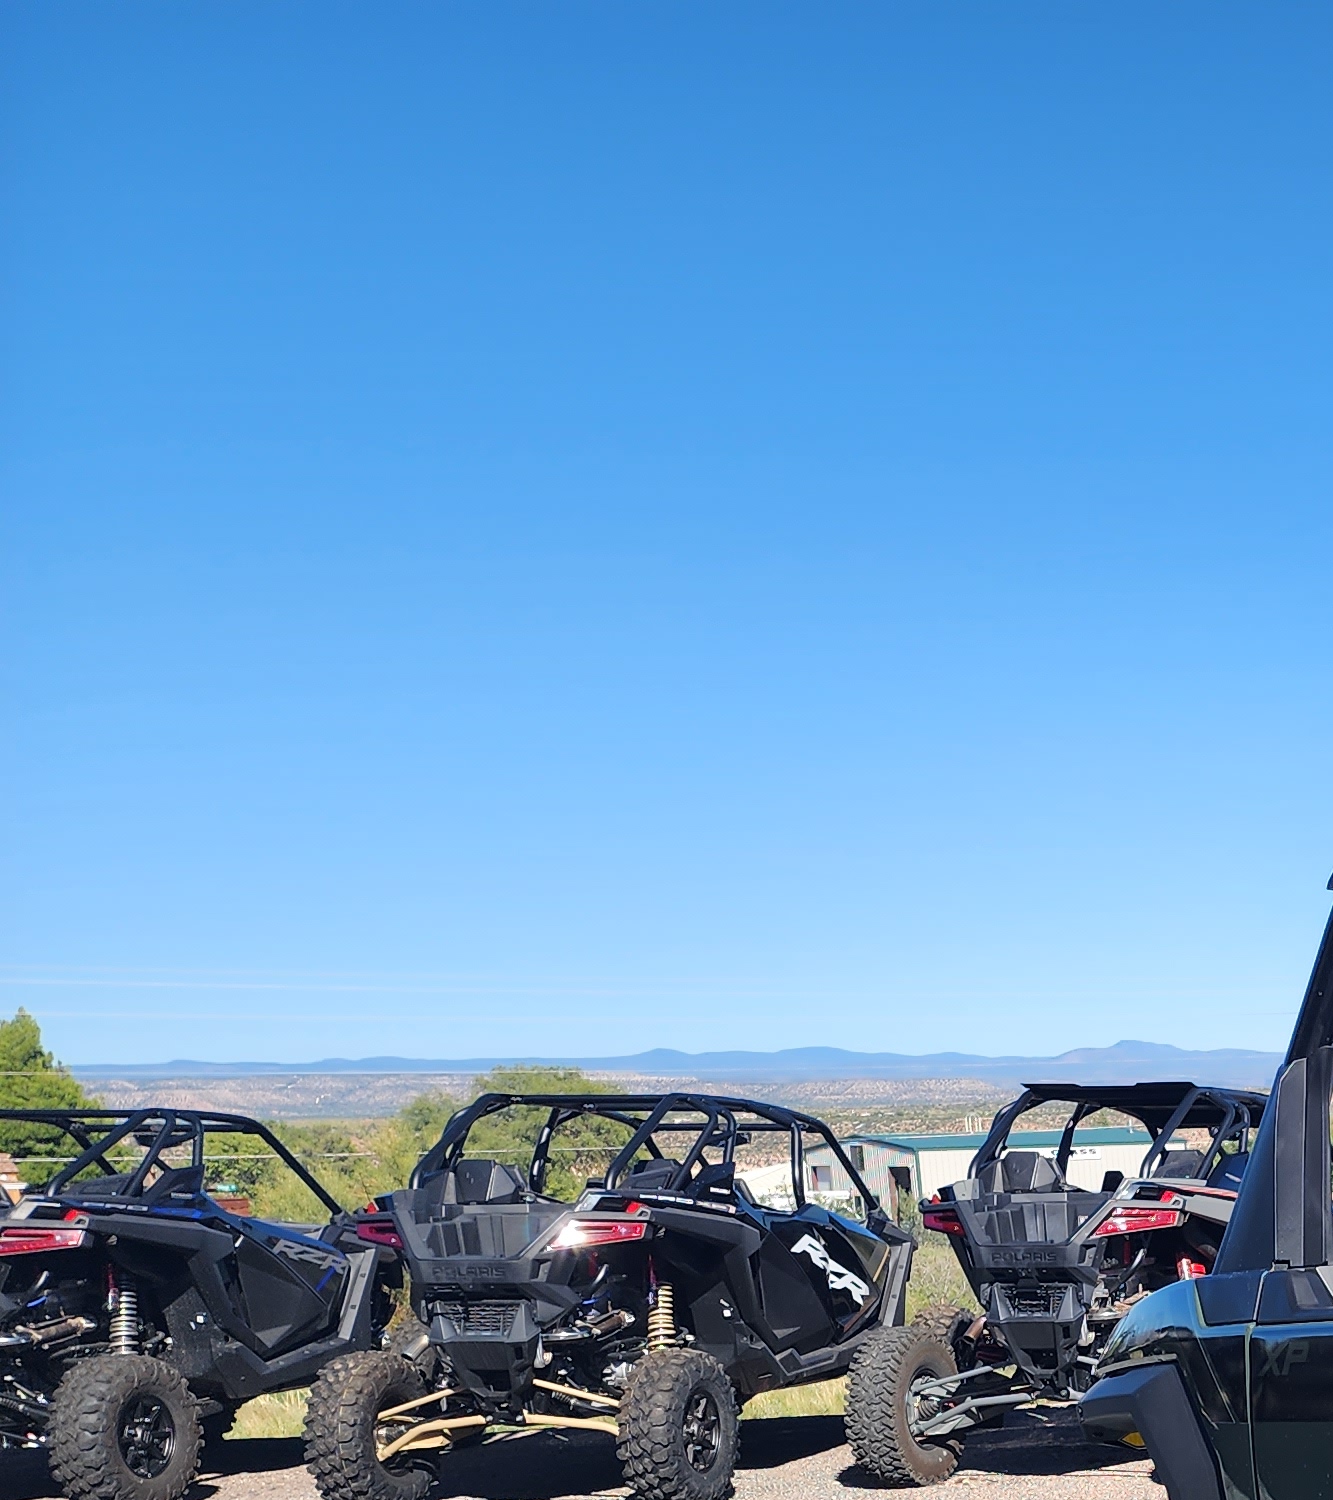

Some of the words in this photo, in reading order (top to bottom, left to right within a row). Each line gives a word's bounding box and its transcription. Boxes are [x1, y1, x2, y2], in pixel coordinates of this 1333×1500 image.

[271, 1238, 350, 1276] RZR
[432, 1266, 505, 1278] POLARIS
[790, 1233, 870, 1307] RZR
[992, 1252, 1057, 1262] POLARIS
[1257, 1339, 1310, 1377] XP
